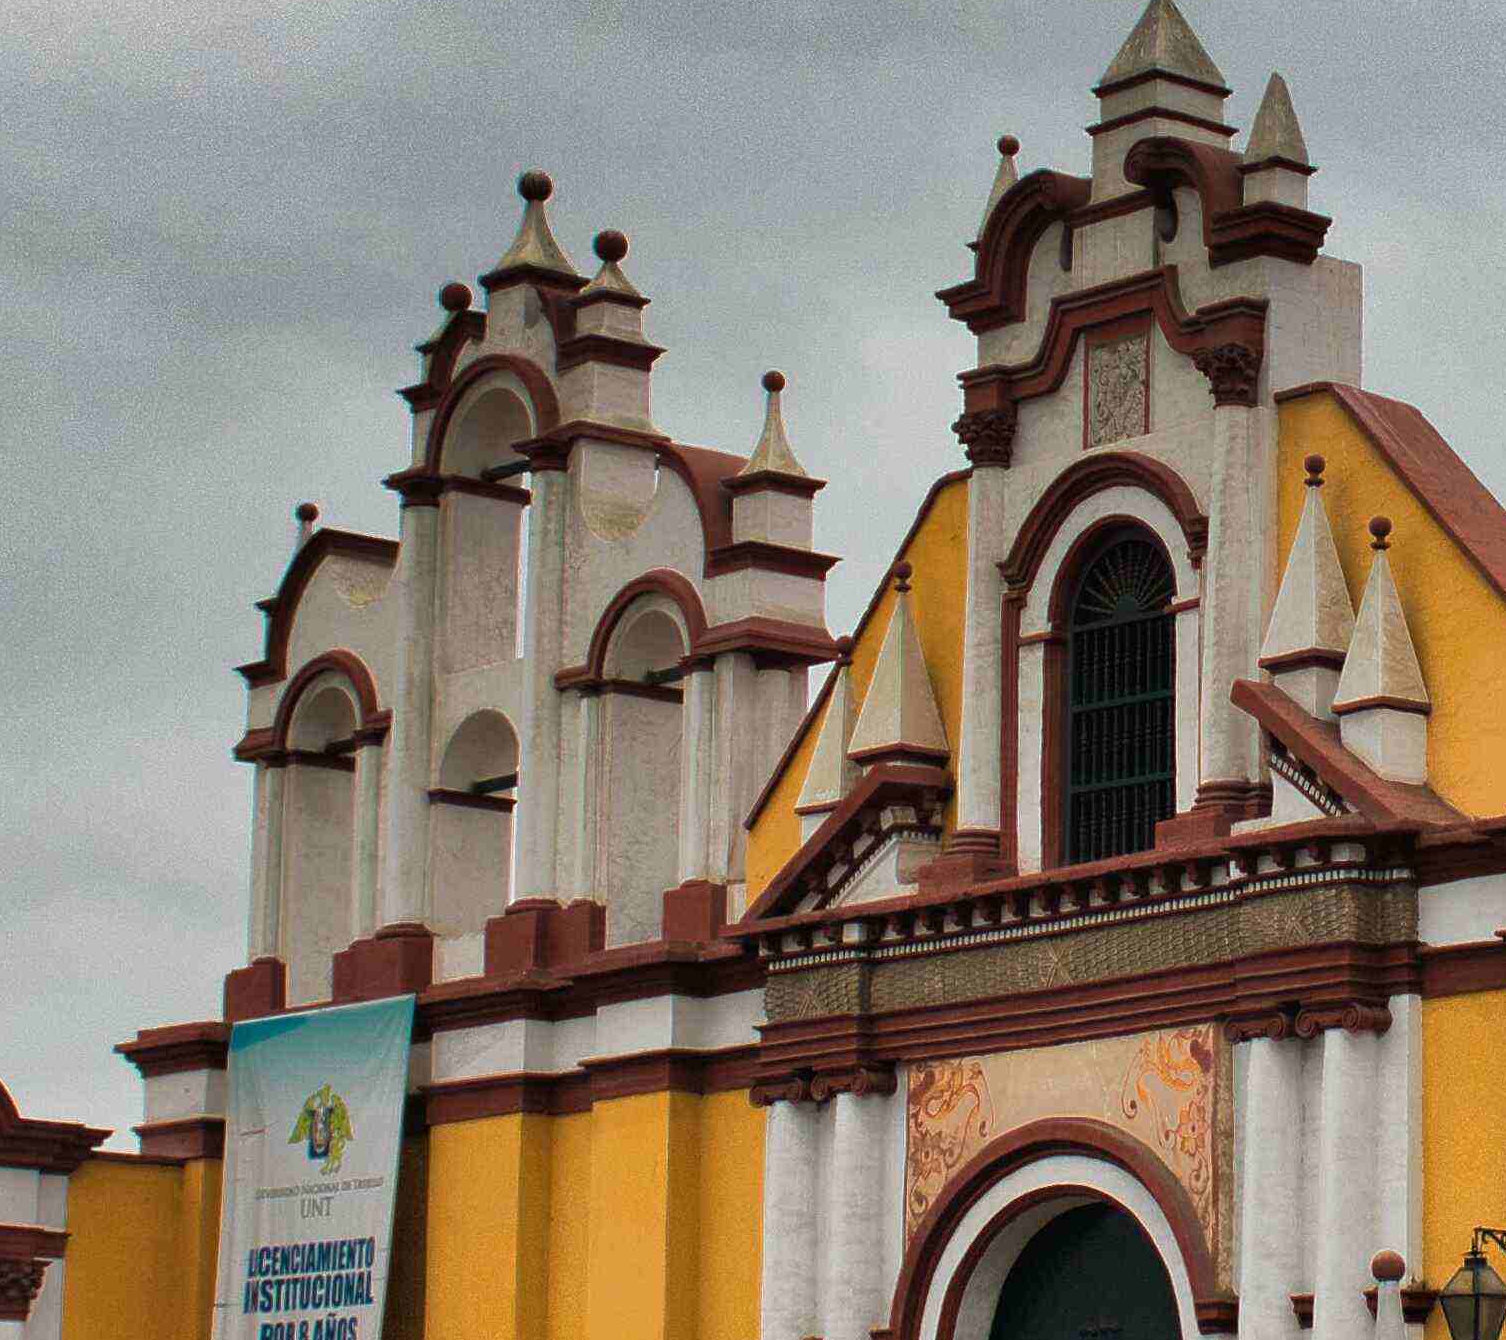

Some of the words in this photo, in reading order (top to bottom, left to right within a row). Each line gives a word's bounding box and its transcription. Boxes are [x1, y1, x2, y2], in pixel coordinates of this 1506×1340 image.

[300, 1196, 334, 1219] UNT
[248, 1236, 376, 1277] LICENCIAMIENTO
[243, 1271, 374, 1314] INSTITUCIONAL
